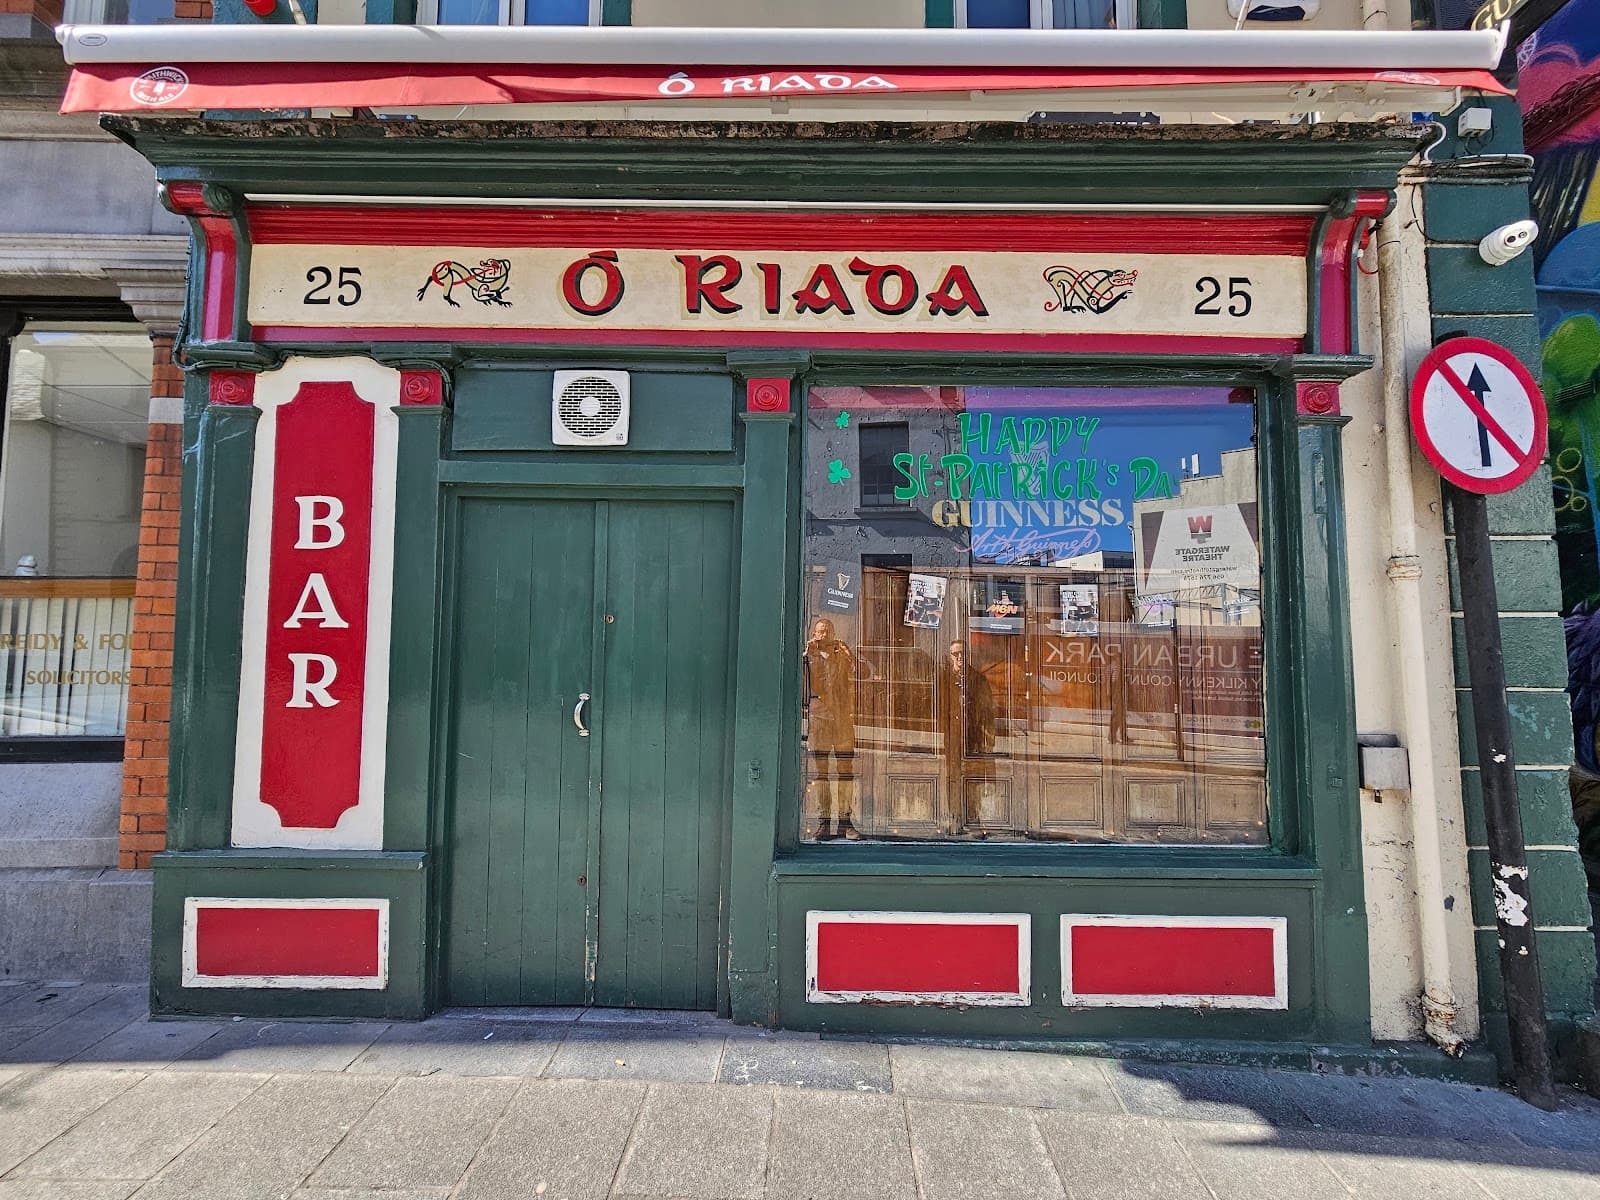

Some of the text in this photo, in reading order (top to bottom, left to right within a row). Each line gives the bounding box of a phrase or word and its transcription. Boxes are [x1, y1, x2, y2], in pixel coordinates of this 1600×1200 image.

[721, 74, 898, 93] RIADA
[303, 265, 362, 306] 25
[674, 256, 989, 317] RIADA
[1194, 276, 1252, 317] 25
[956, 412, 1100, 456] HAPPY
[931, 498, 1125, 529] GUINNESS
[283, 495, 349, 708] BAR
[74, 633, 88, 650] &
[26, 670, 131, 685] SOLICITORS
